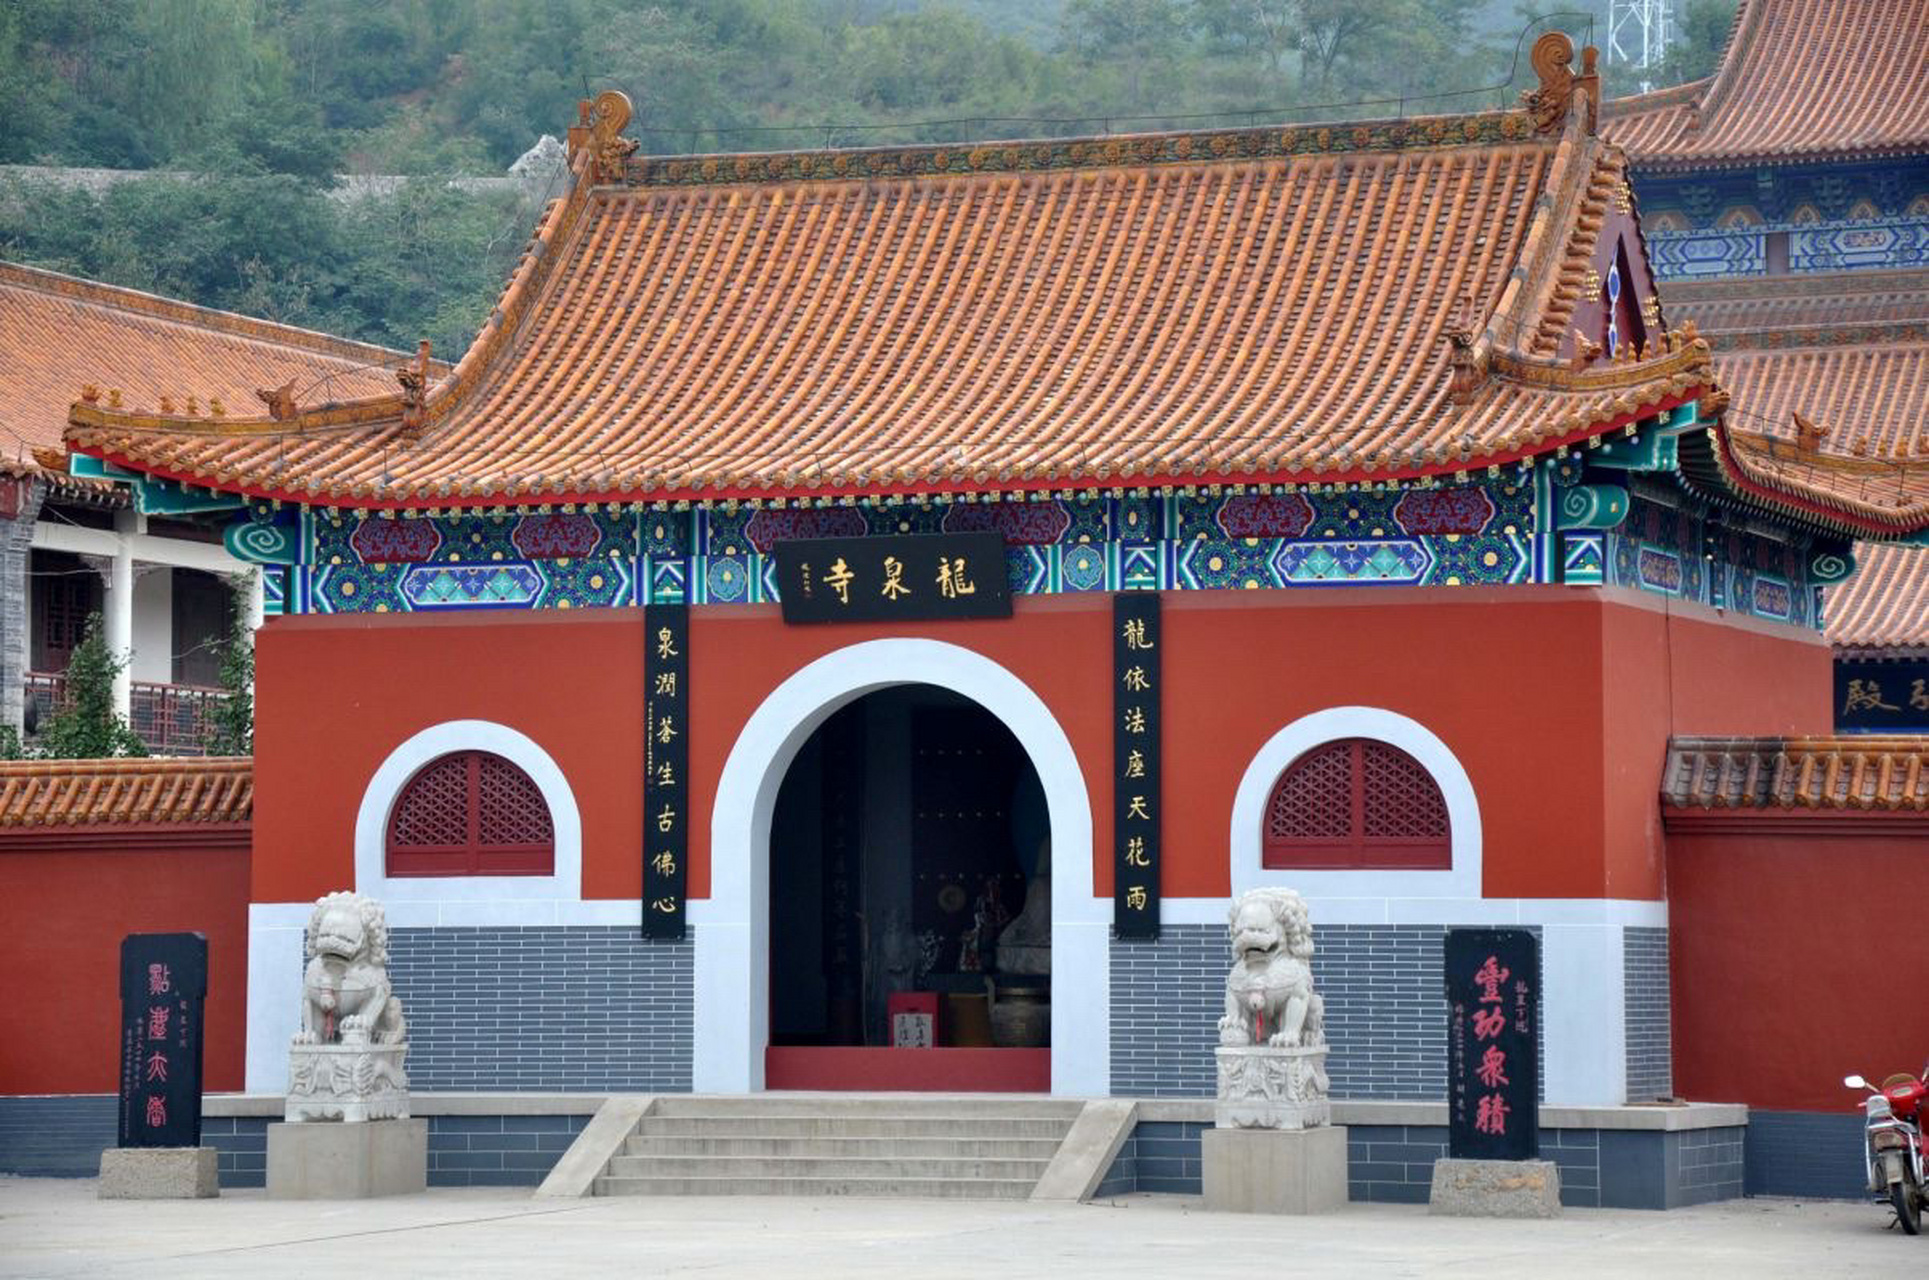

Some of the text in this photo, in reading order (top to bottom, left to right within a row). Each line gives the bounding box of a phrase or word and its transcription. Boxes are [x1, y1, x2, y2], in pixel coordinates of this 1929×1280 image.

[823, 557, 975, 604] 龍泉寺
[652, 627, 679, 913] 泉潤蒼生古佛心
[1123, 618, 1154, 911] 龍依法座天花雨
